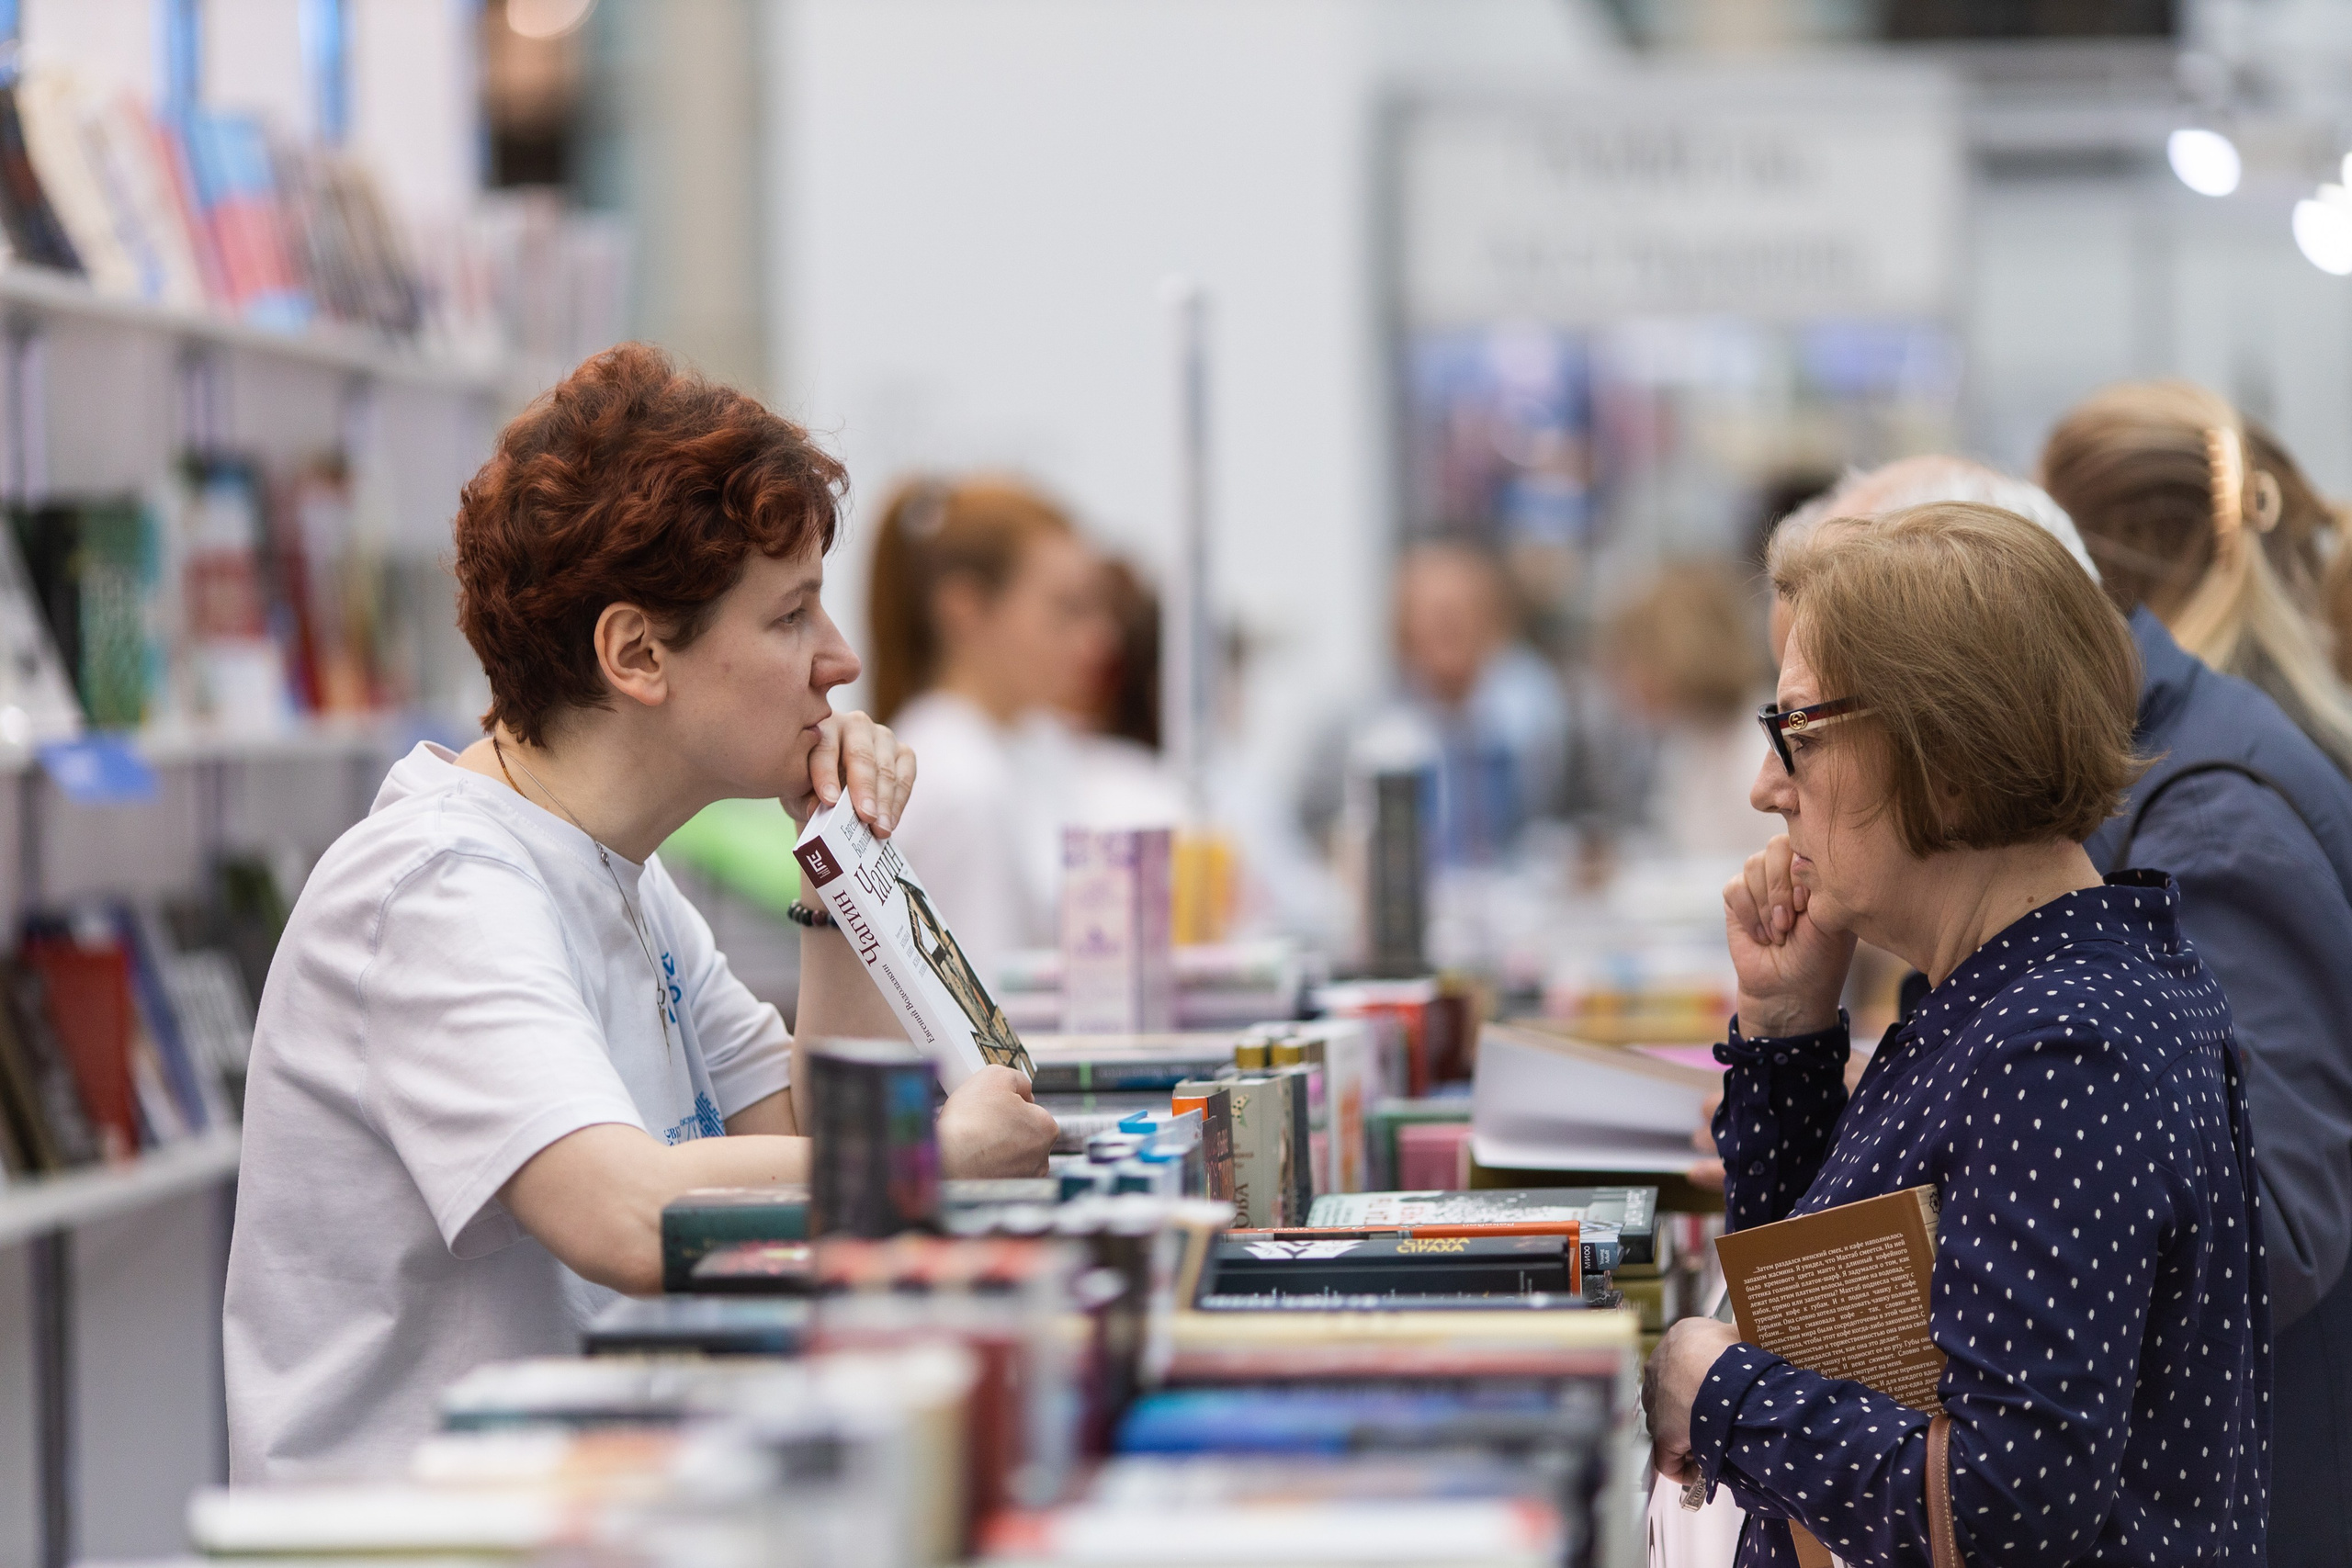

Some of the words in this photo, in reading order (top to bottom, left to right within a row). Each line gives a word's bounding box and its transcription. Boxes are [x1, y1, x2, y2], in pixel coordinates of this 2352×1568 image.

[840, 812, 860, 840] Евгени
[854, 840, 904, 907] Чагин
[832, 889, 881, 967] Чагин
[882, 964, 914, 1011] Водолазкин
[910, 1010, 935, 1043] Евгений
[1396, 1244, 1464, 1254] СТРАХА
[1744, 1274, 1768, 1284] запахом
[1836, 1250, 1859, 1261] Махтаб
[1894, 1239, 1905, 1247] ней
[1774, 1258, 1801, 1269] раздался
[1802, 1250, 1827, 1261] женский
[1849, 1242, 1864, 1250] кафе
[1864, 1233, 1904, 1247] наполнилось
[1746, 1284, 1761, 1292] было
[1764, 1276, 1795, 1289] кремового
[1797, 1271, 1815, 1280] цвета
[1817, 1266, 1836, 1275] манто
[1846, 1256, 1873, 1269] длинный
[1875, 1248, 1907, 1260] кофейного
[1747, 1291, 1771, 1300] оттенка
[1772, 1281, 1800, 1294] головной
[1848, 1264, 1879, 1276] задумался
[1750, 1300, 1768, 1308] лежат
[1780, 1292, 1794, 1301] этим
[1795, 1287, 1820, 1297] платком
[1844, 1275, 1870, 1285] похожие
[1754, 1313, 1782, 1325] турецким
[1785, 1308, 1801, 1316] кофе
[1848, 1292, 1870, 1301] поднял
[1872, 1286, 1892, 1294] чашку
[1901, 1280, 1917, 1288] кофе
[1771, 1303, 1791, 1312] прямо
[1804, 1290, 1838, 1303] заплетены?
[1838, 1283, 1861, 1294] Махтаб
[1862, 1279, 1890, 1289] поднесла
[1890, 1273, 1909, 1282] чашку
[1795, 1314, 1816, 1322] словно
[1816, 1308, 1837, 1317] хотела
[1837, 1300, 1871, 1312] поцеловать
[1871, 1295, 1890, 1303] чашку
[1891, 1288, 1918, 1299] полными
[1760, 1334, 1801, 1348] удовольствия
[1817, 1325, 1833, 1334] были
[1834, 1314, 1879, 1330] сосредоточены
[1883, 1309, 1898, 1318] этой
[1898, 1305, 1917, 1314] чашке
[1804, 1317, 1836, 1328] смаковала
[1840, 1312, 1855, 1320] кофе
[1885, 1300, 1906, 1309] словно
[1782, 1345, 1824, 1359] степенностью
[1829, 1330, 1885, 1348] торжественностью
[1913, 1319, 1928, 1327] свой
[1803, 1337, 1822, 1345] чтобы
[1837, 1329, 1851, 1337] кофе
[1851, 1322, 1884, 1334] когда-либо
[1793, 1351, 1832, 1365] наслаждался
[1804, 1362, 1821, 1371] берет
[1822, 1358, 1840, 1366] чашку
[1847, 1349, 1874, 1360] подносит
[1904, 1338, 1920, 1348] Губы
[1897, 1348, 1920, 1357] Словно
[1853, 1366, 1877, 1376] смотрит
[1860, 1372, 1887, 1383] Дыхание
[1894, 1381, 1923, 1392] едва-едва
[1897, 1372, 1923, 1382] каждого
[1923, 1368, 1940, 1376] вдоха
